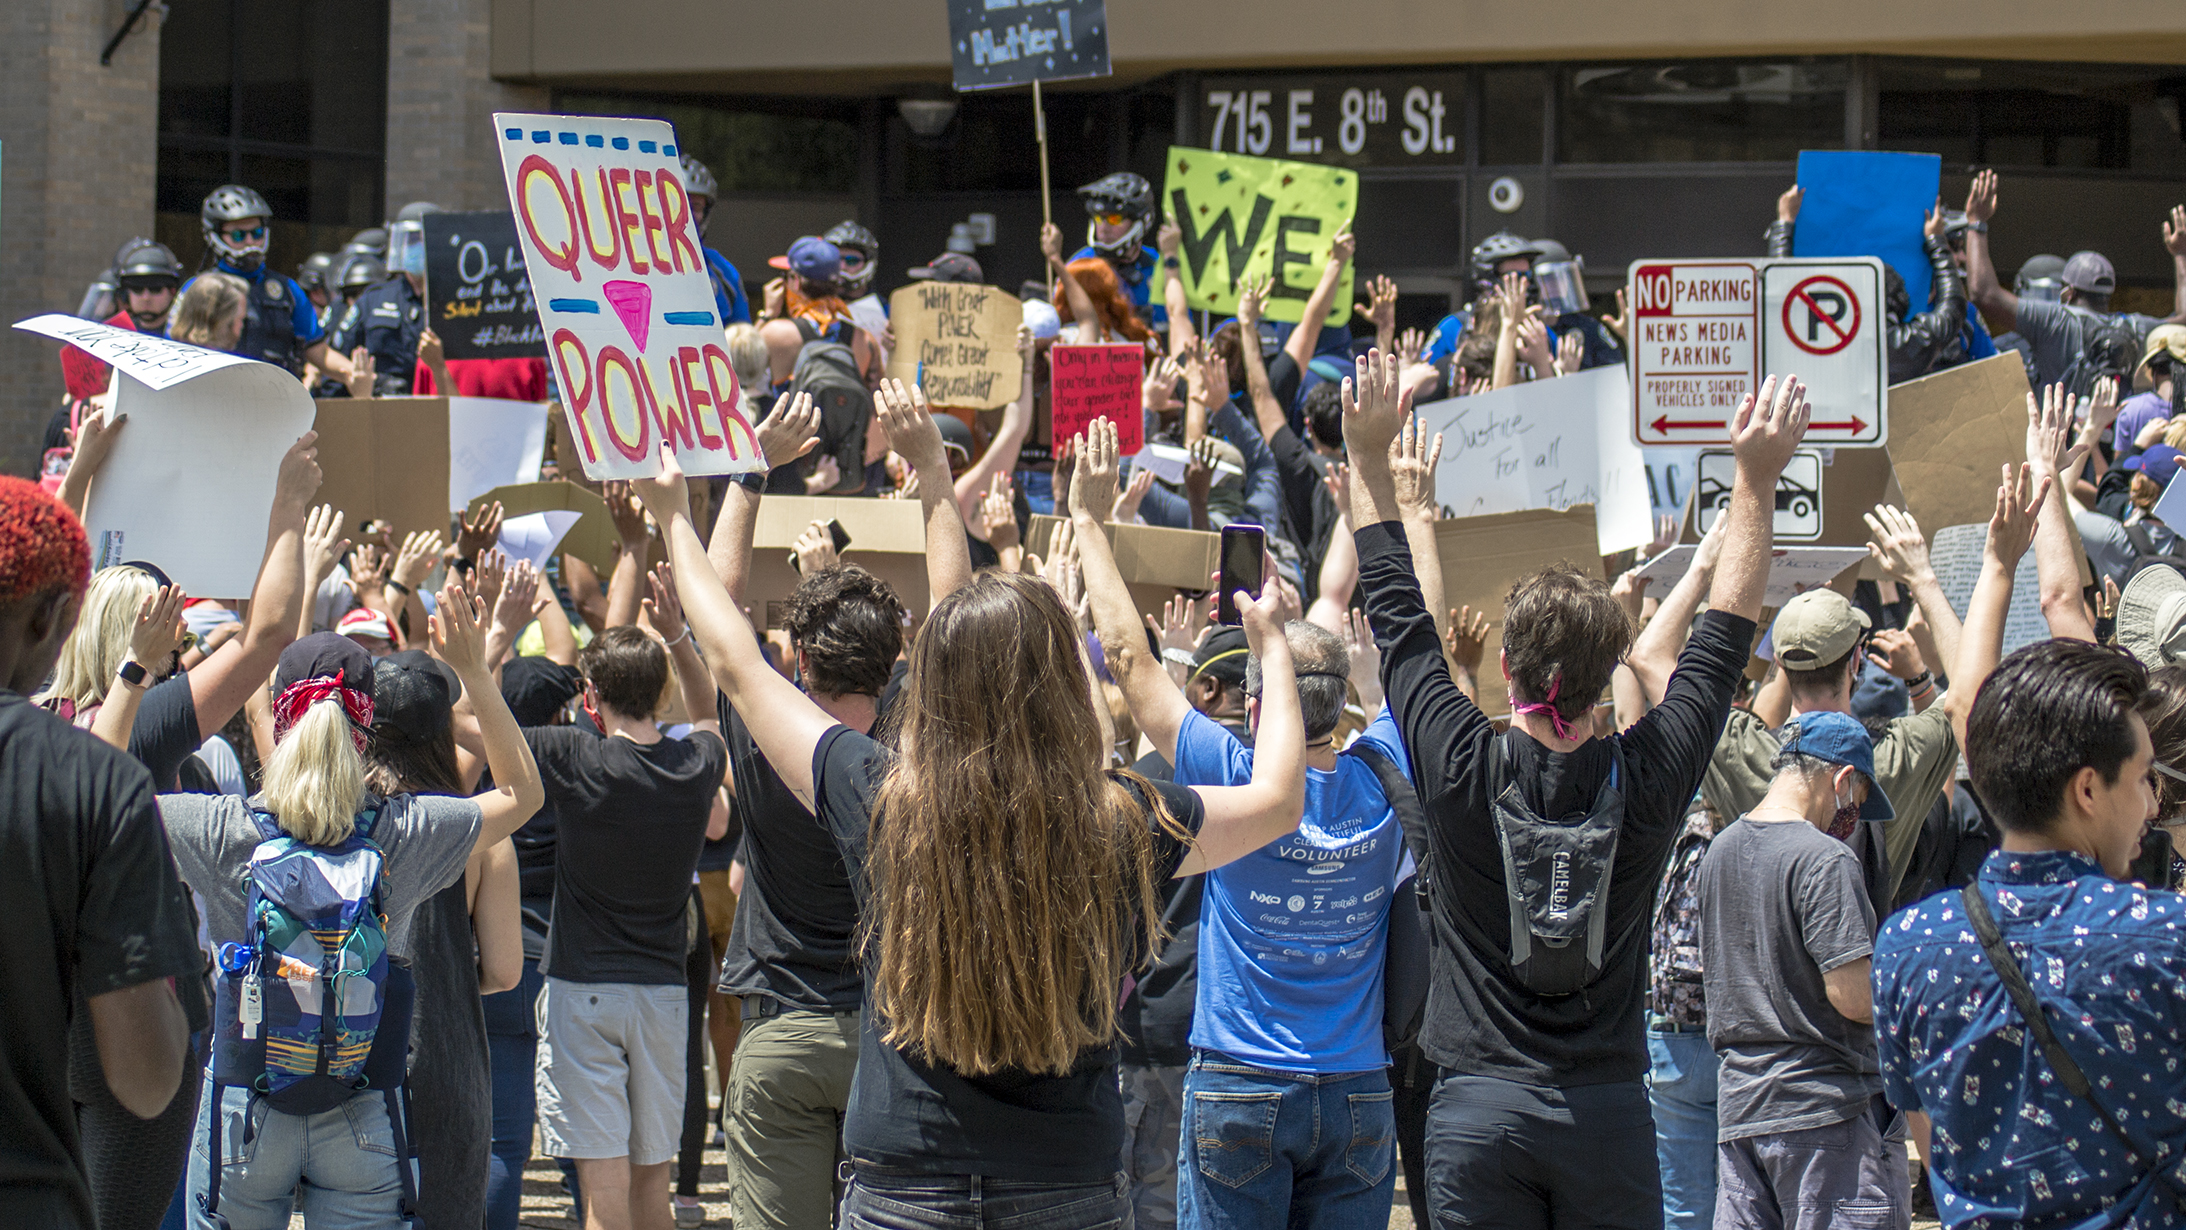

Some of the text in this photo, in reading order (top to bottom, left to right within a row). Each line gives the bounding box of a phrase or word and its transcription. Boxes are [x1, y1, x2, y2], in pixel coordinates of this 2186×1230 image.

[970, 9, 1074, 66] Matter!
[1208, 86, 1456, 155] 715 E. 8th St.
[516, 154, 703, 283] QUEER
[1170, 187, 1322, 300] WE
[1637, 274, 1751, 310] NO PARKING
[1646, 322, 1747, 342] NEWS MEDIA
[1059, 349, 1088, 379] Only
[1090, 352, 1101, 364] in
[1661, 346, 1732, 365] PARKING
[552, 328, 763, 464] POWER
[1648, 379, 1746, 393] PROPERLY SIGNED
[1656, 393, 1737, 407] VEHICLES ONLY
[1441, 408, 1535, 463] Justice
[1490, 435, 1562, 480] For all
[1329, 817, 1363, 832] AUSTIN
[1279, 838, 1377, 861] VOLUNTEER
[1293, 836, 1322, 848] CLEAN
[1350, 830, 1369, 844] 2017
[1311, 863, 1341, 871] SAMSUNG
[1549, 851, 1571, 920] CAMELBAK
[1313, 901, 1322, 910] 7
[1299, 919, 1338, 928] DentaQuest
